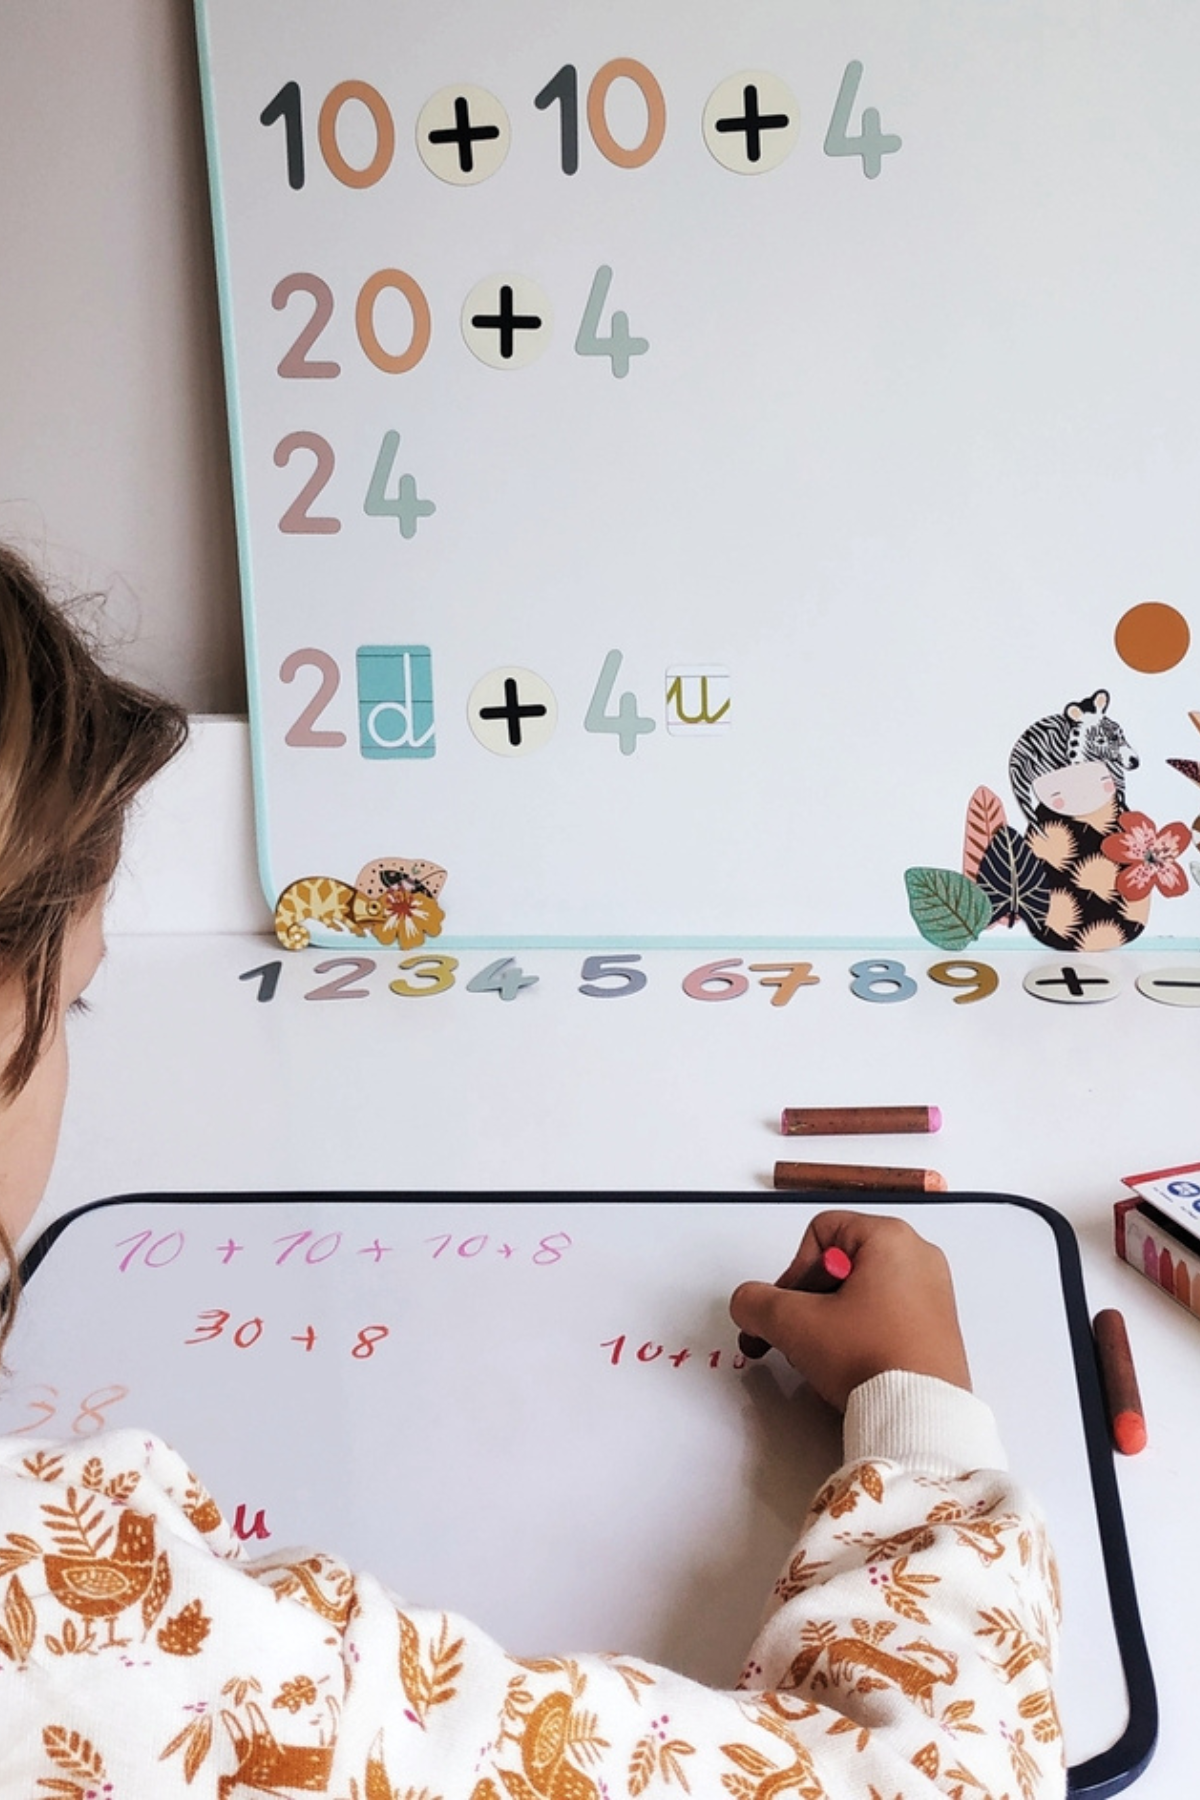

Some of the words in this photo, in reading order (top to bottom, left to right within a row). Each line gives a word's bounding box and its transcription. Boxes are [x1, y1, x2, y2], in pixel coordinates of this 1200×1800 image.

[260, 80, 395, 190] 10
[534, 57, 667, 175] 10
[823, 59, 902, 180] 4
[271, 268, 431, 379] 20
[575, 264, 649, 378] 4
[273, 429, 436, 540] 24
[184, 1308, 265, 1349] 30
[351, 1324, 390, 1360] 8
